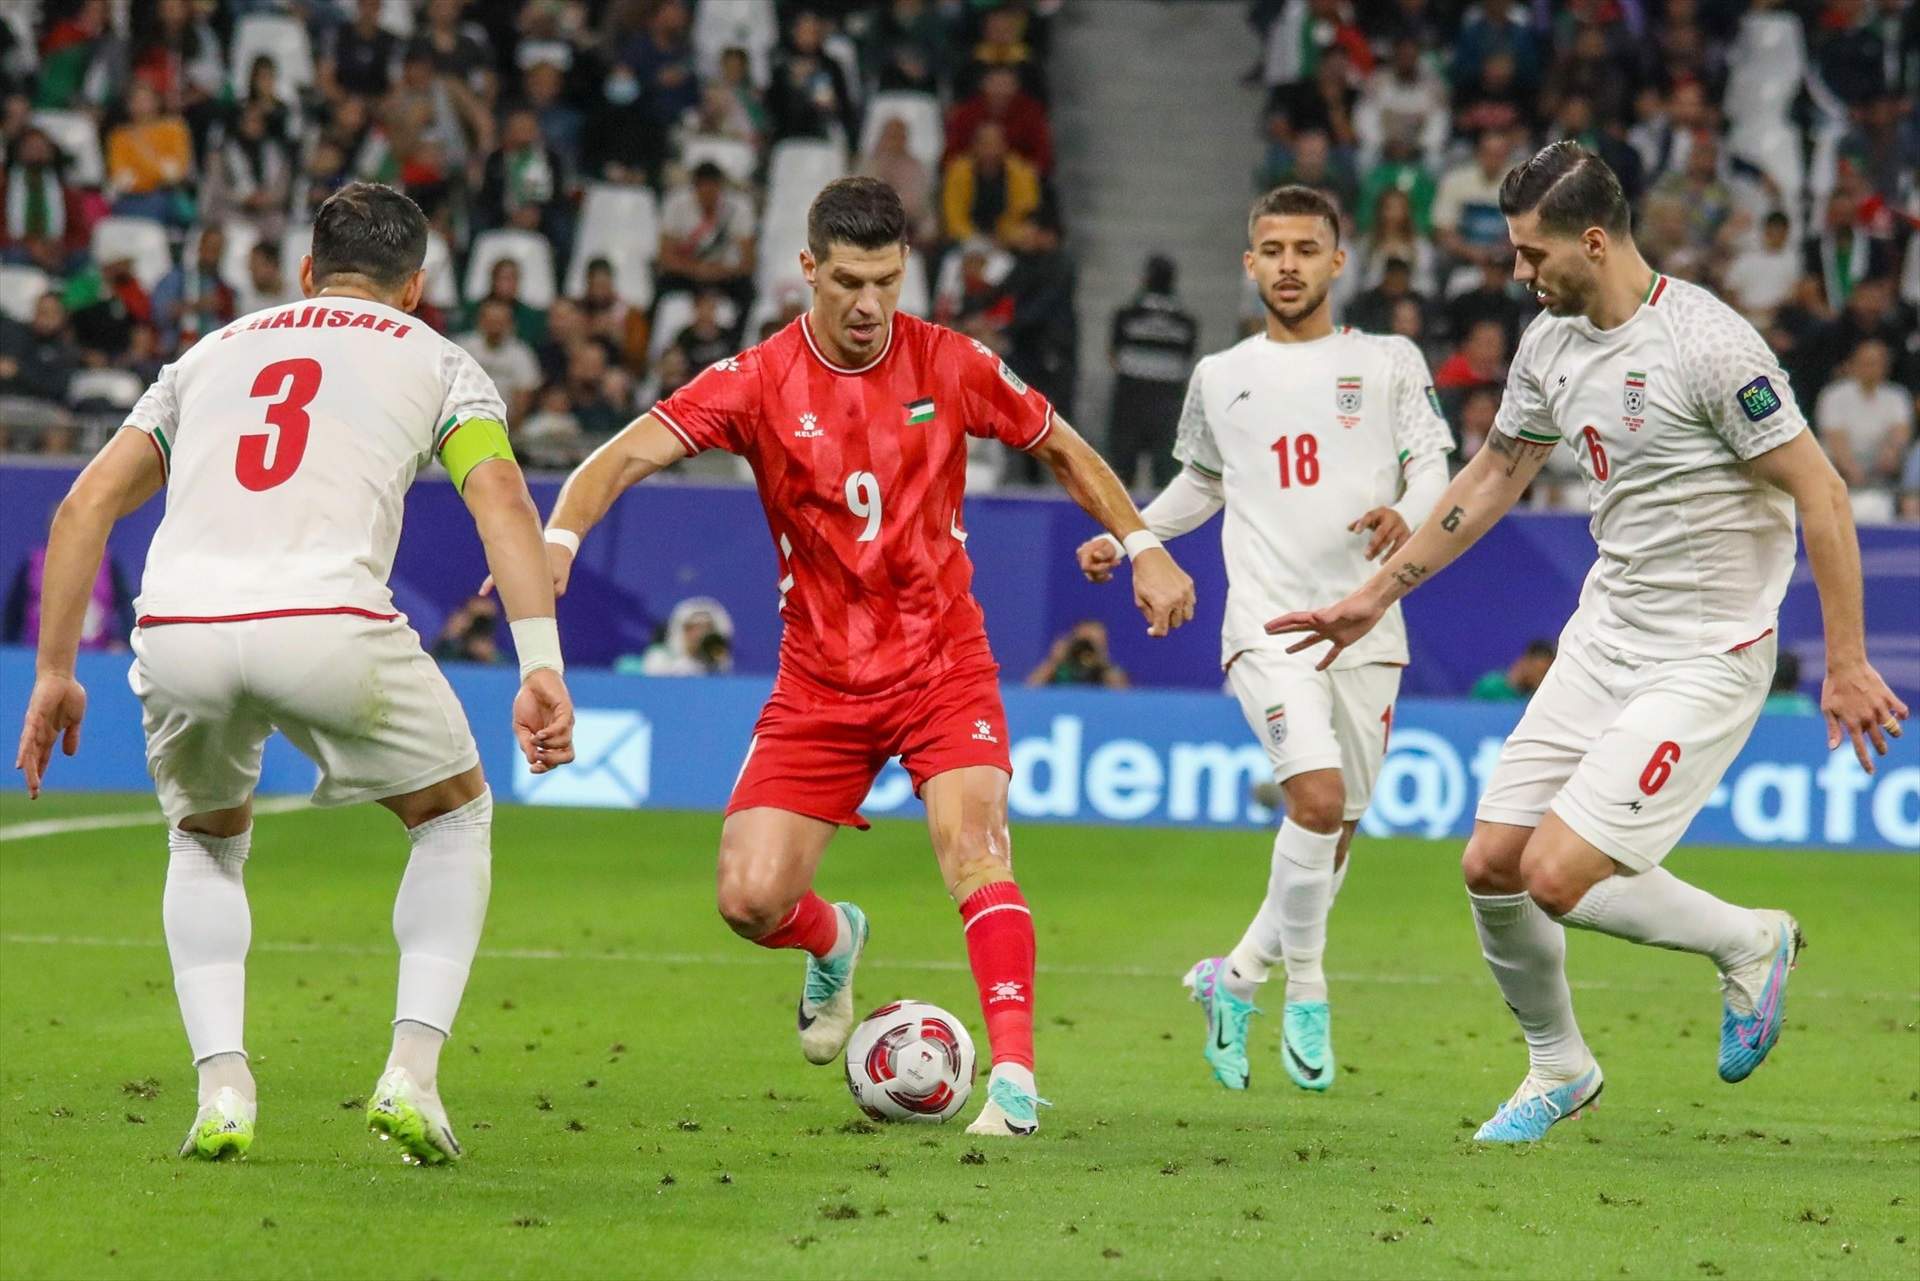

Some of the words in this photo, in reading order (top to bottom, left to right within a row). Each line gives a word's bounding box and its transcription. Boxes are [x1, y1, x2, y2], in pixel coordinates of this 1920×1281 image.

[235, 358, 323, 492] 3
[1583, 425, 1608, 481] 6
[1270, 433, 1320, 489] 18
[845, 470, 882, 542] 9
[1639, 741, 1680, 796] 6
